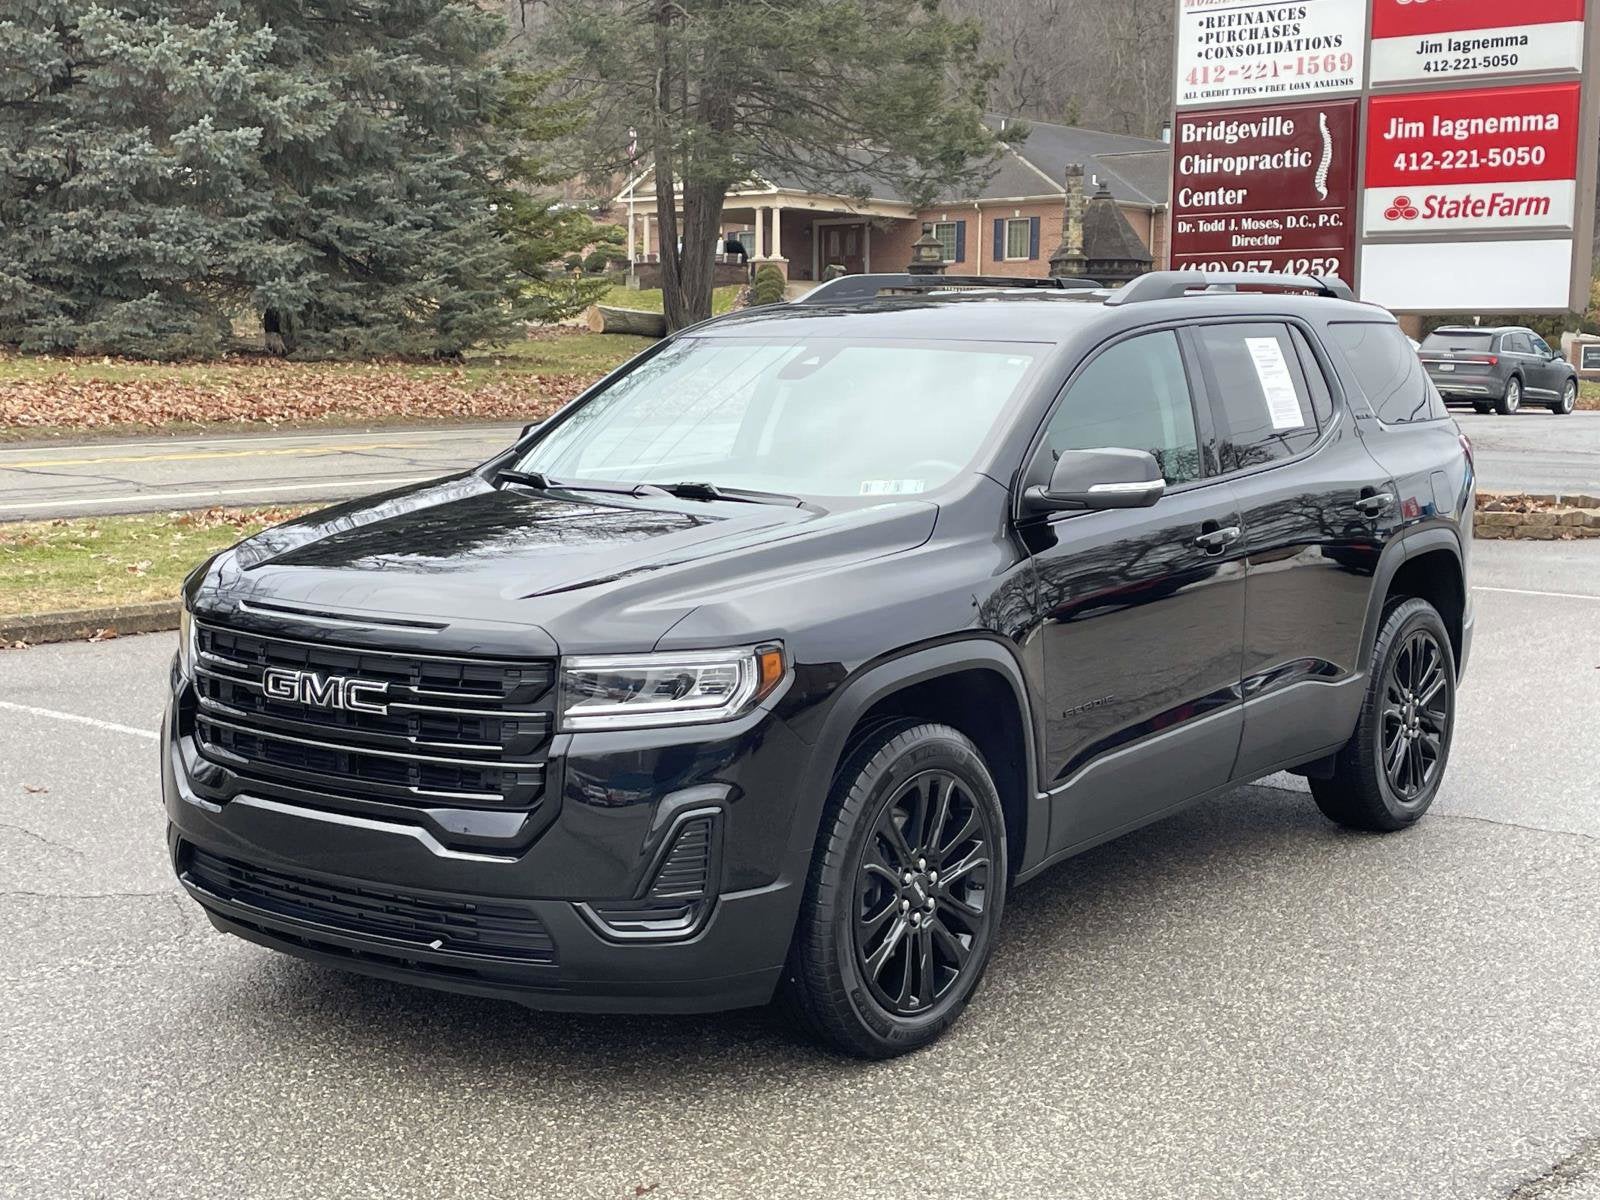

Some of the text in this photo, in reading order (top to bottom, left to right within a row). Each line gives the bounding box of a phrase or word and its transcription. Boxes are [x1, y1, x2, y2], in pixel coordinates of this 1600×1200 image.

[1205, 6, 1307, 29] REFINANCES
[1205, 23, 1300, 45] PURCHASES
[1416, 34, 1528, 55] Jim Iagnemma
[1204, 34, 1343, 60] CONSOLIDATIONS
[1185, 52, 1353, 86] 412-221-1569
[1423, 53, 1519, 73] 412-221-5050
[1184, 77, 1354, 100] ALL CREDIT TYPES FREE LOAN ANALYSIS
[1181, 116, 1294, 144] Bridgeville
[1383, 113, 1559, 141] Jim Iagnemma
[1179, 147, 1312, 176] Chiropractic
[1394, 145, 1546, 171] 412-221-5050
[1178, 187, 1248, 208] Center
[1177, 213, 1343, 233] Dr. Todd J. Moses, D.C., P.C.
[1231, 234, 1283, 247] Director
[262, 667, 389, 716] GMC
